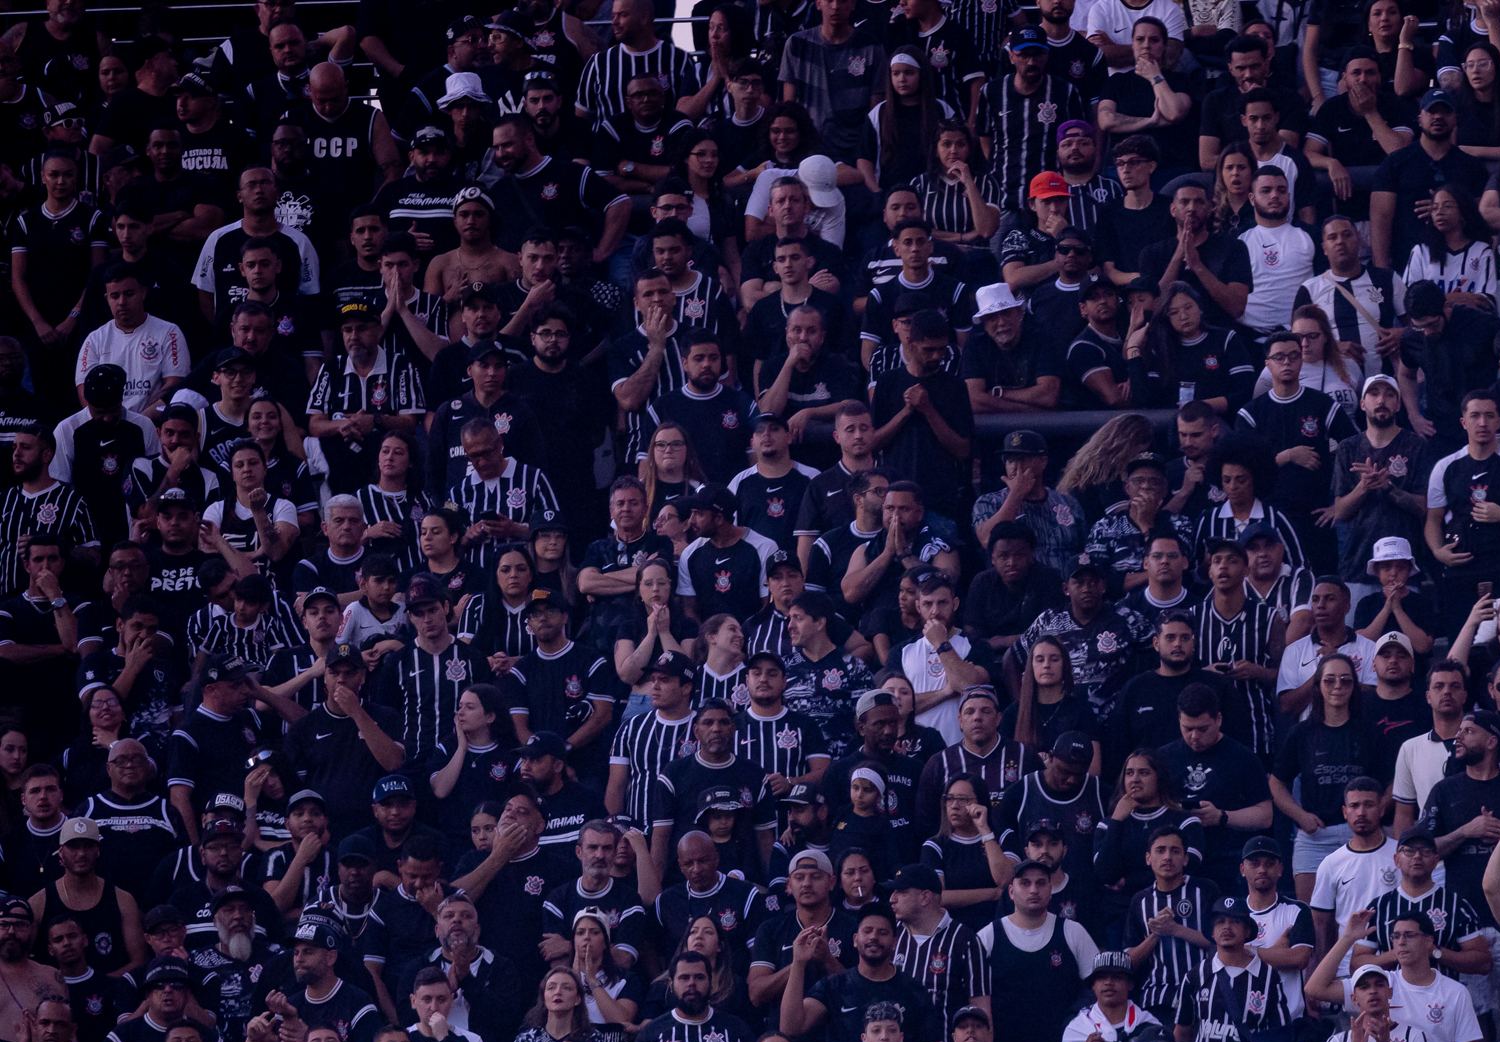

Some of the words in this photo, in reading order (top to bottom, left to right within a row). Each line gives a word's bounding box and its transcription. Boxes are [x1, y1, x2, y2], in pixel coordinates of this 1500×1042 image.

[189, 148, 213, 156] ESTADO
[215, 148, 223, 156] DE
[308, 137, 359, 159] CCP
[399, 199, 458, 211] CORINTHIAN
[312, 372, 331, 407] bozano
[162, 569, 177, 580] OS
[180, 567, 195, 578] DE
[214, 793, 245, 811] OSASCO
[546, 813, 585, 830] NTHIANS
